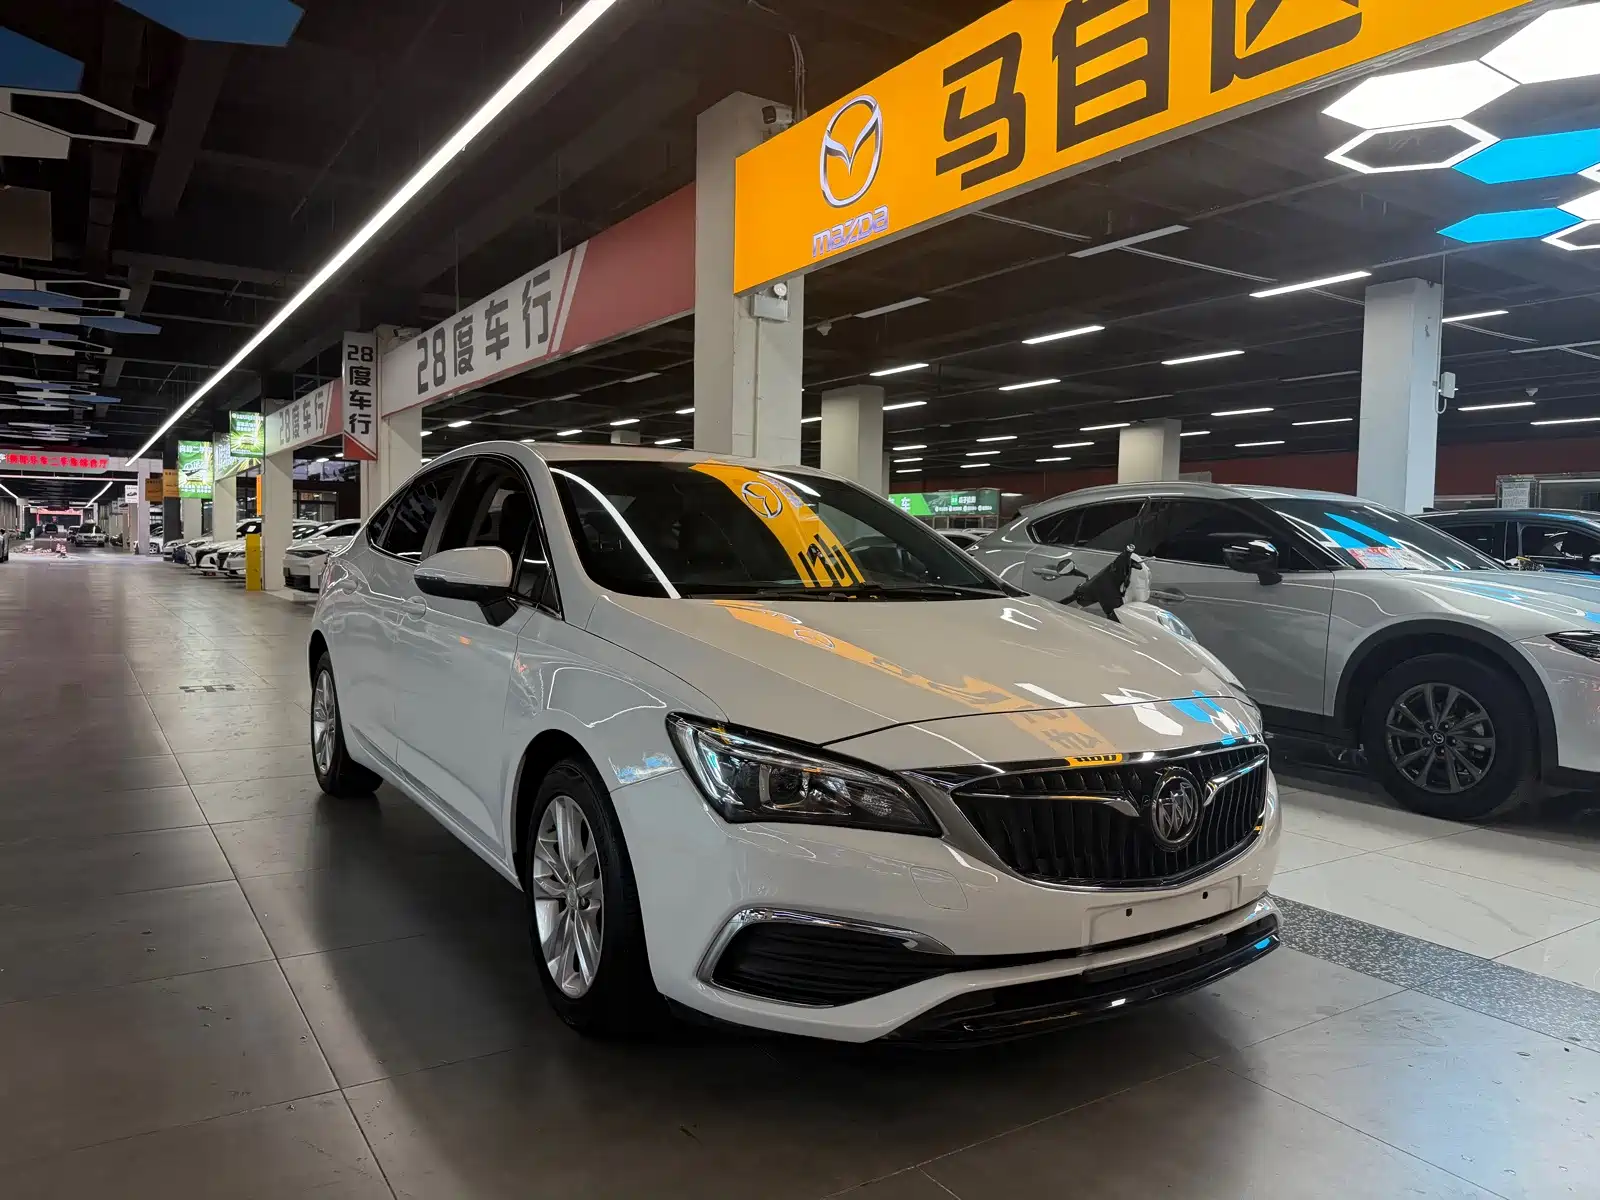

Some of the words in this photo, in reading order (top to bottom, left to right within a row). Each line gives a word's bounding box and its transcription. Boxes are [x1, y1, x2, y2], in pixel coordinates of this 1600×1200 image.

[416, 268, 552, 396] 28度车行
[279, 391, 324, 445] 28度车行
[346, 344, 374, 435] 28度车行
